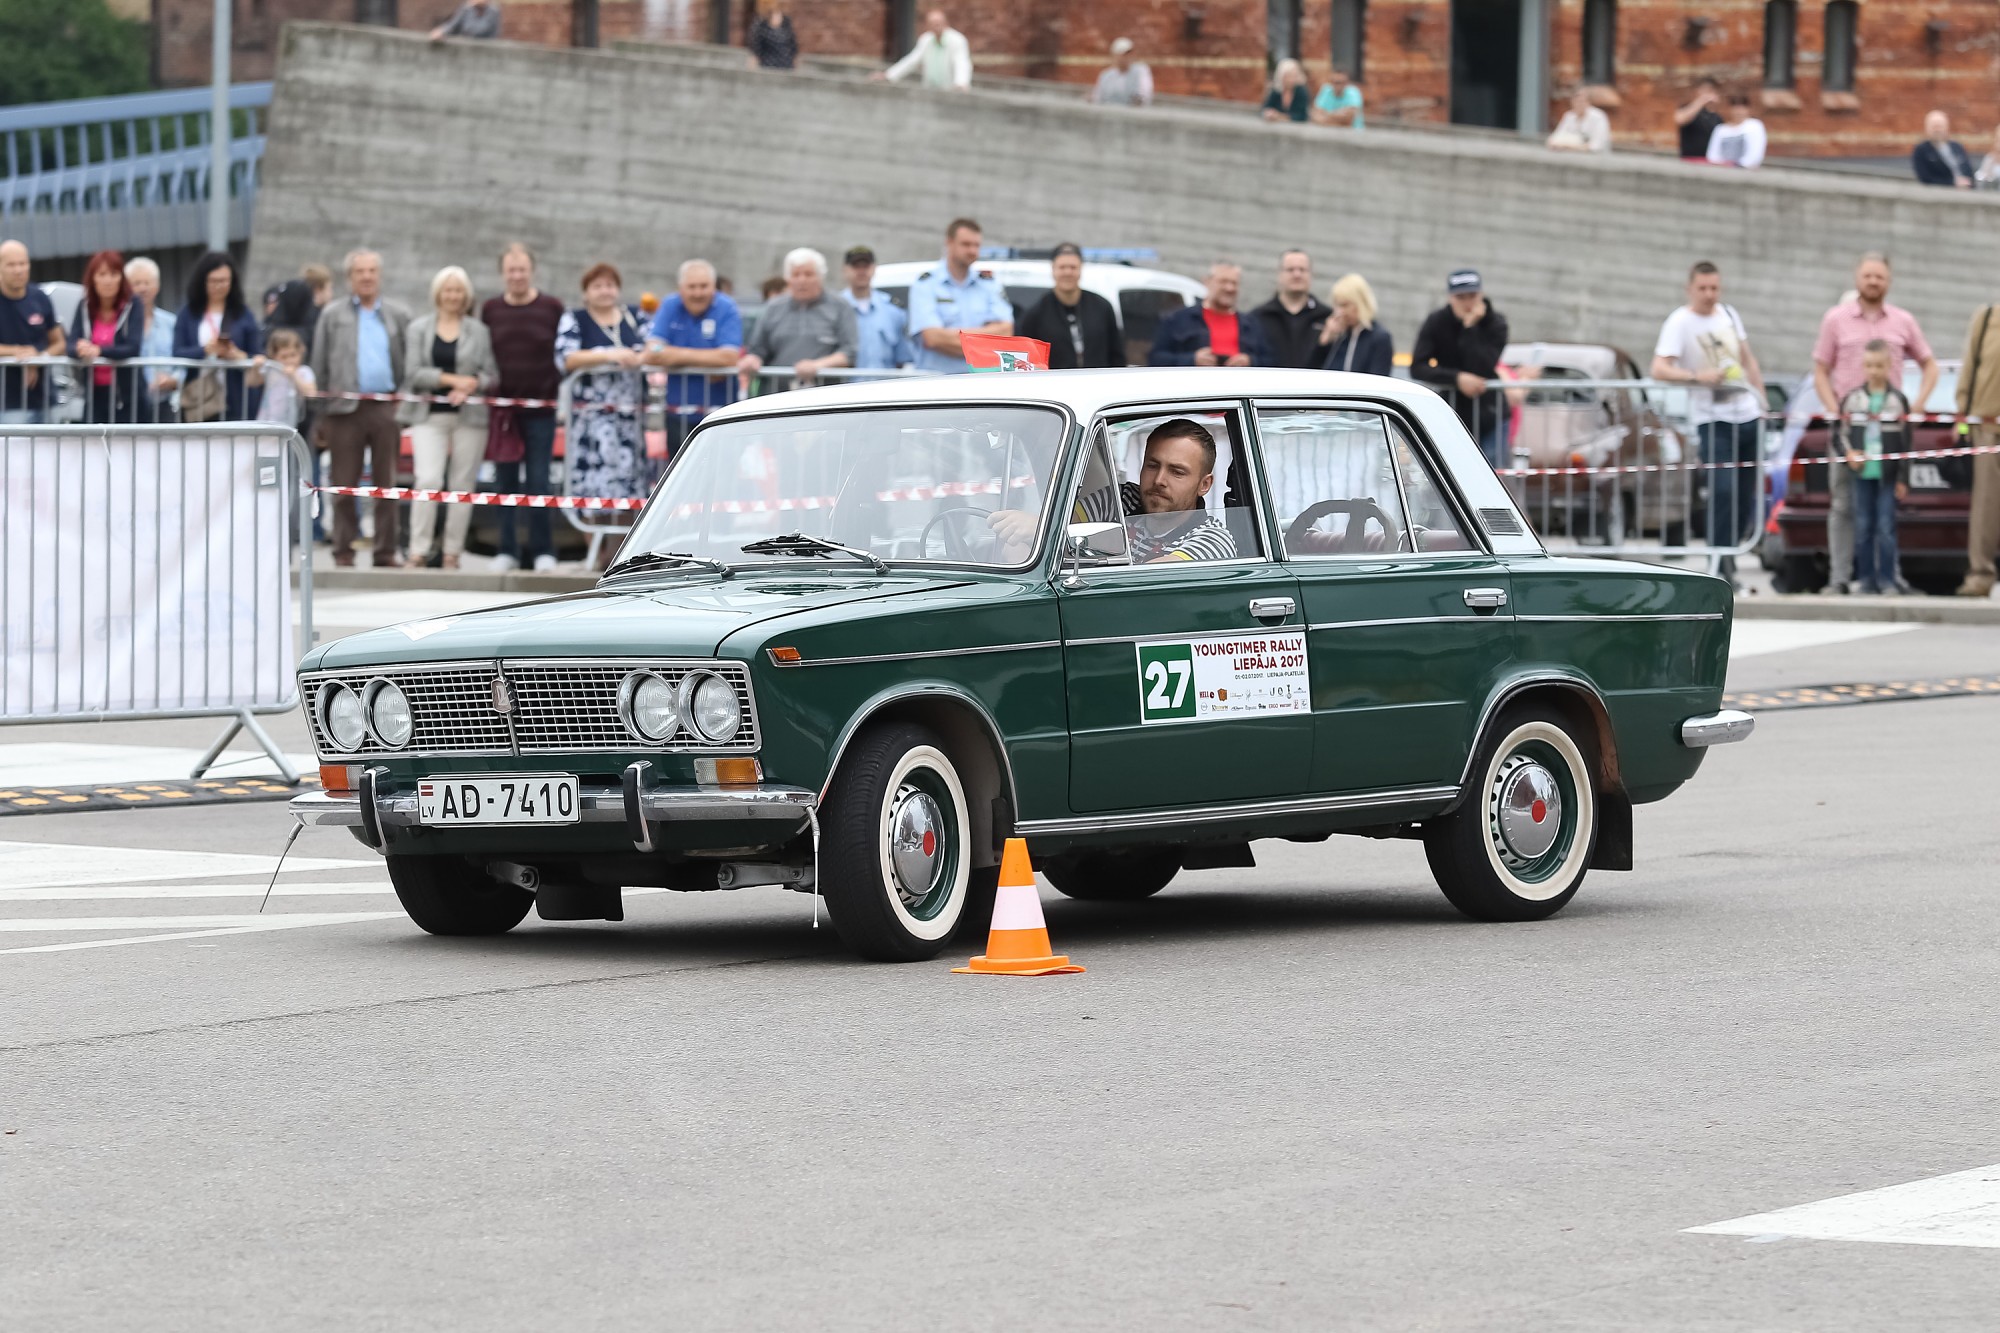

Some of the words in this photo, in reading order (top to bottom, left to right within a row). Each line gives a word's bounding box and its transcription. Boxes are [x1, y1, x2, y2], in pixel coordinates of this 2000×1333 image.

[1194, 642, 1267, 657] YOUNGTIMER
[1270, 638, 1302, 652] RALLY
[1233, 653, 1278, 671] LIEPĀJA
[1280, 654, 1304, 668] 2017
[1144, 659, 1192, 710] 27
[442, 782, 573, 818] AD-7410
[421, 806, 435, 818] LV
